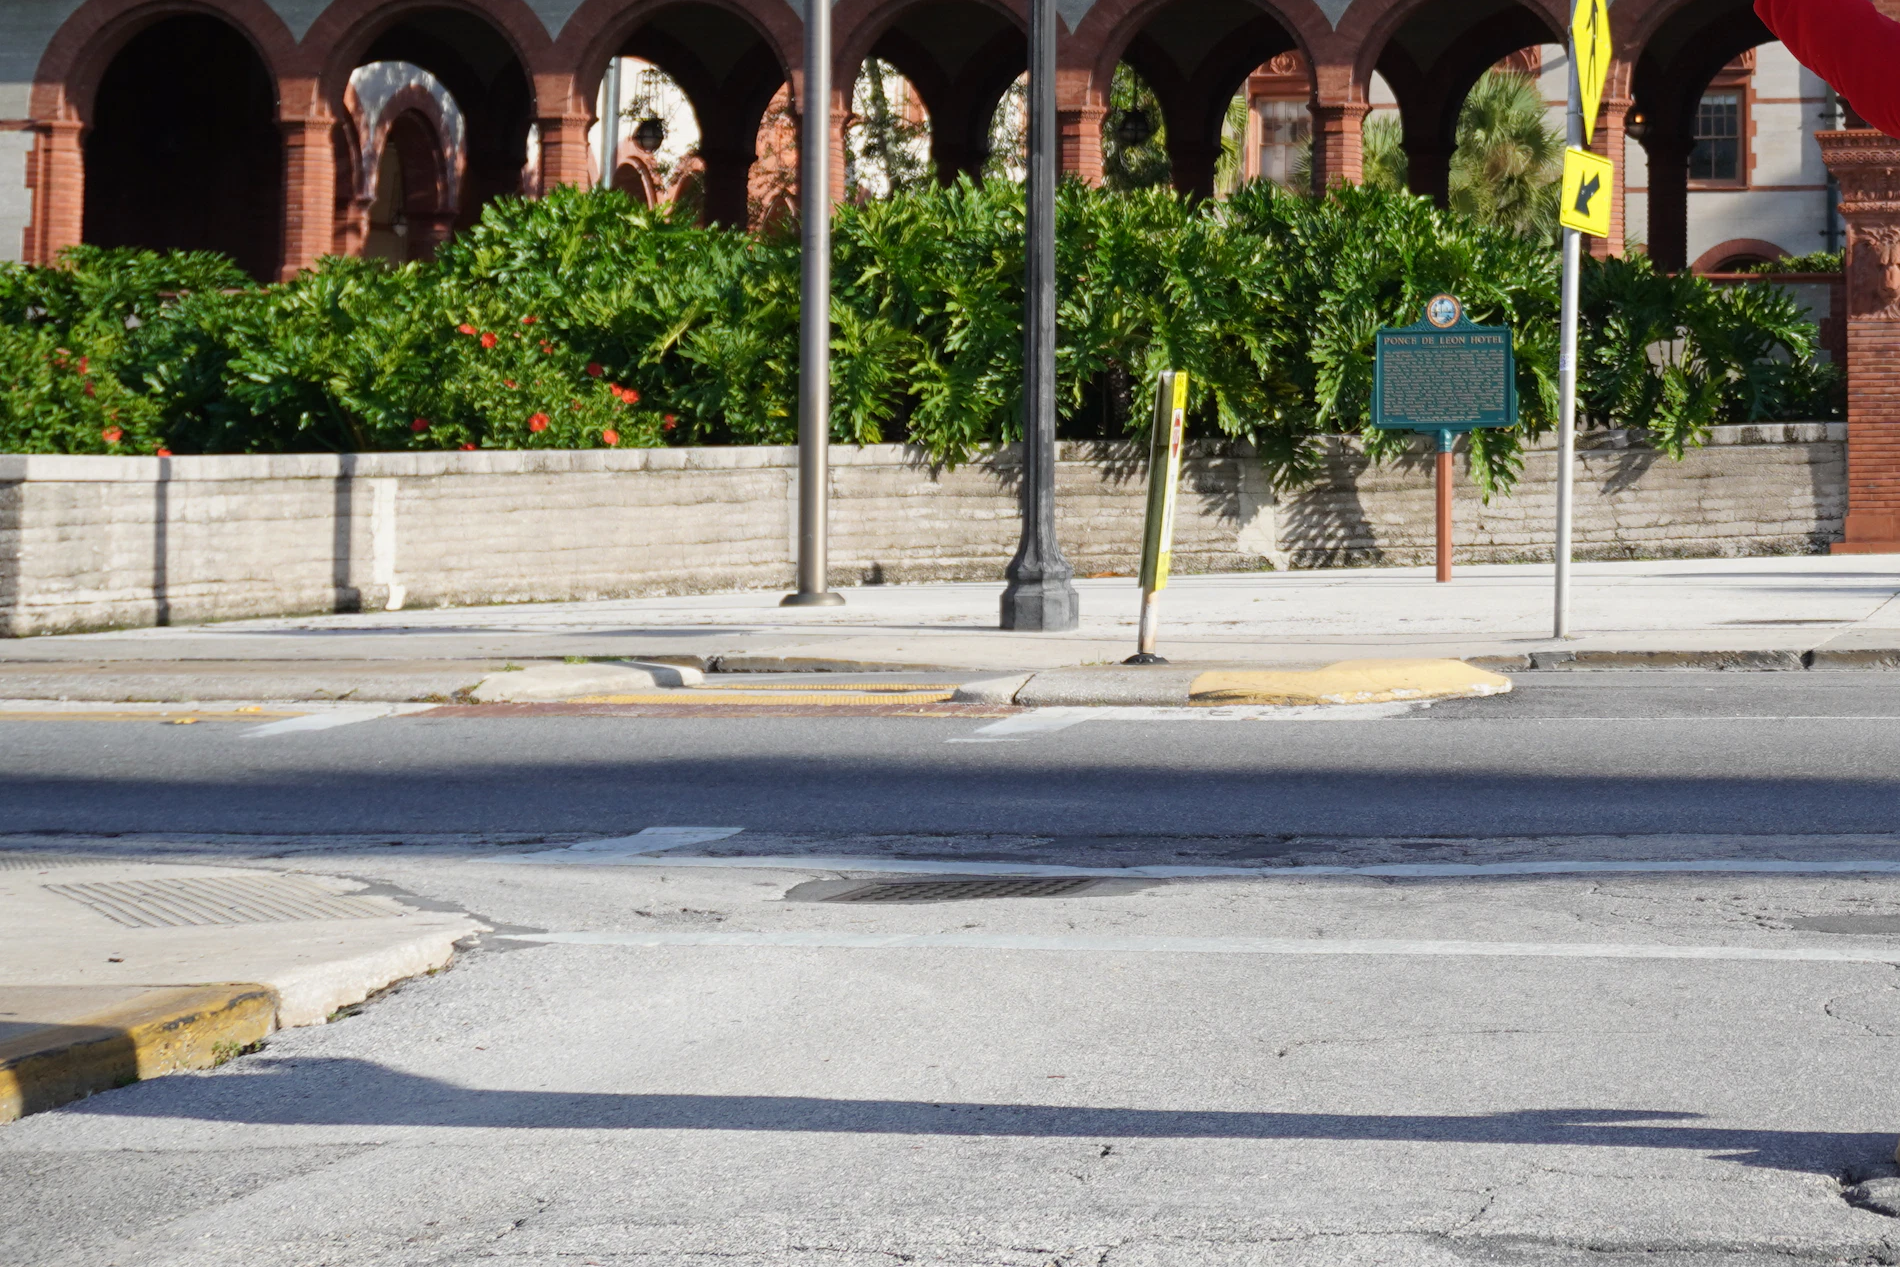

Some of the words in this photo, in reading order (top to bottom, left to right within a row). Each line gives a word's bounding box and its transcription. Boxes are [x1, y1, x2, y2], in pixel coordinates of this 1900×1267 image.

[1383, 336, 1417, 345] PONCE
[1421, 336, 1435, 345] DE
[1439, 336, 1466, 345] LEON
[1470, 335, 1504, 344] HOTEL
